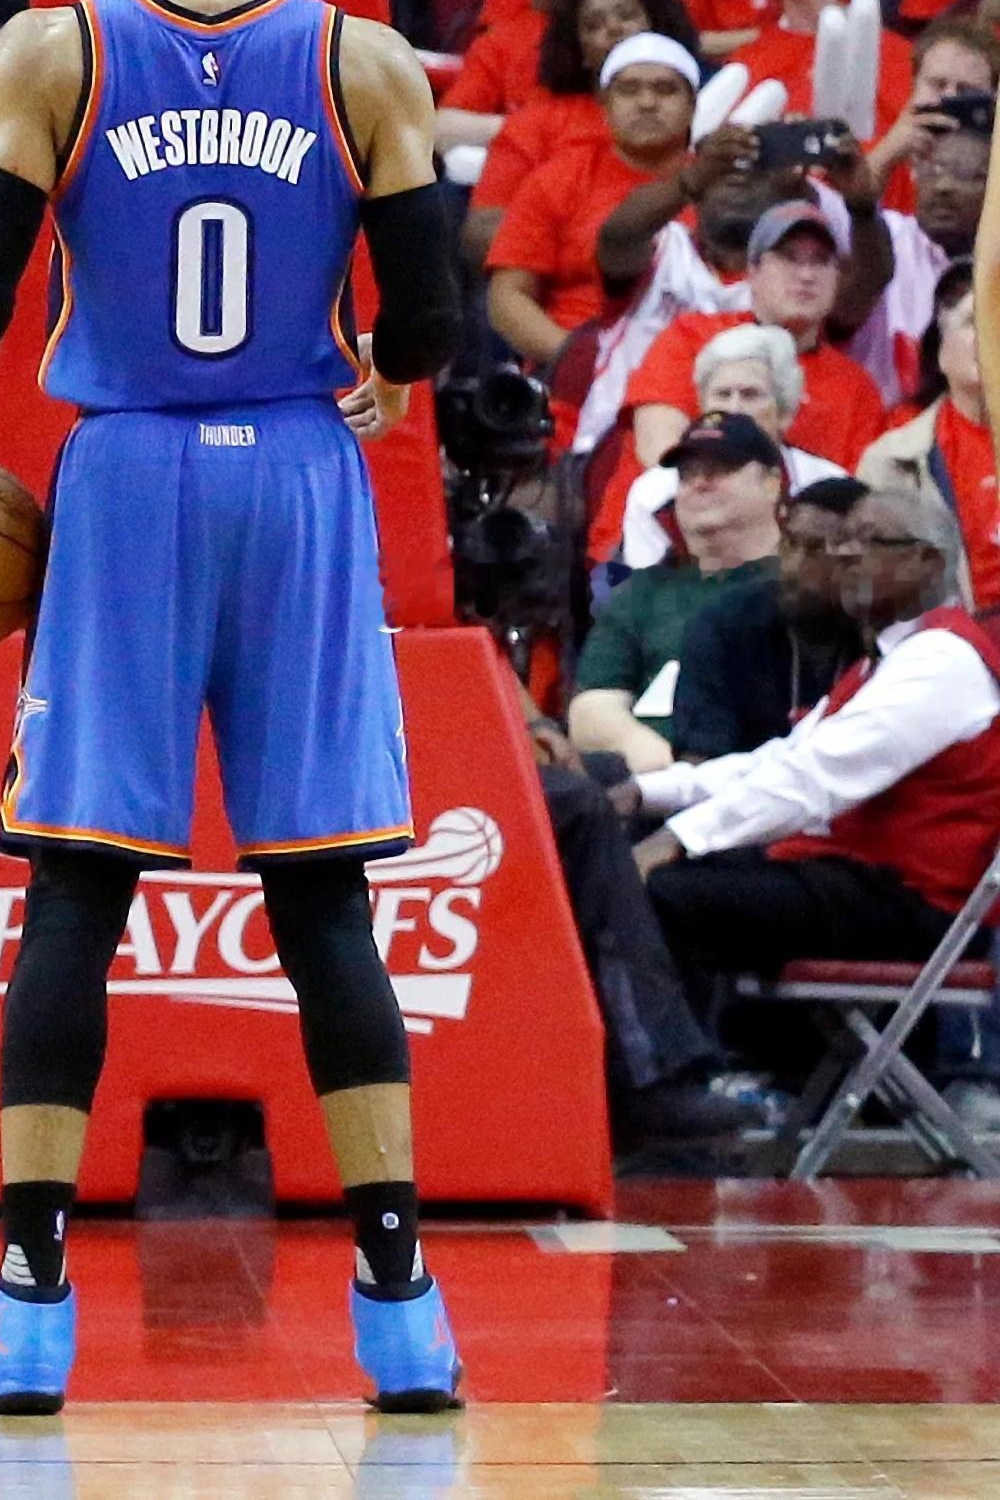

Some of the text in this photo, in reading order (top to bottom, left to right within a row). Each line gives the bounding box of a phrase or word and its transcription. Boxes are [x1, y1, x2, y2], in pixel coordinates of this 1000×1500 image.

[105, 108, 317, 185] WESTBROOK
[174, 200, 250, 356] 0
[199, 422, 256, 447] THUNDER
